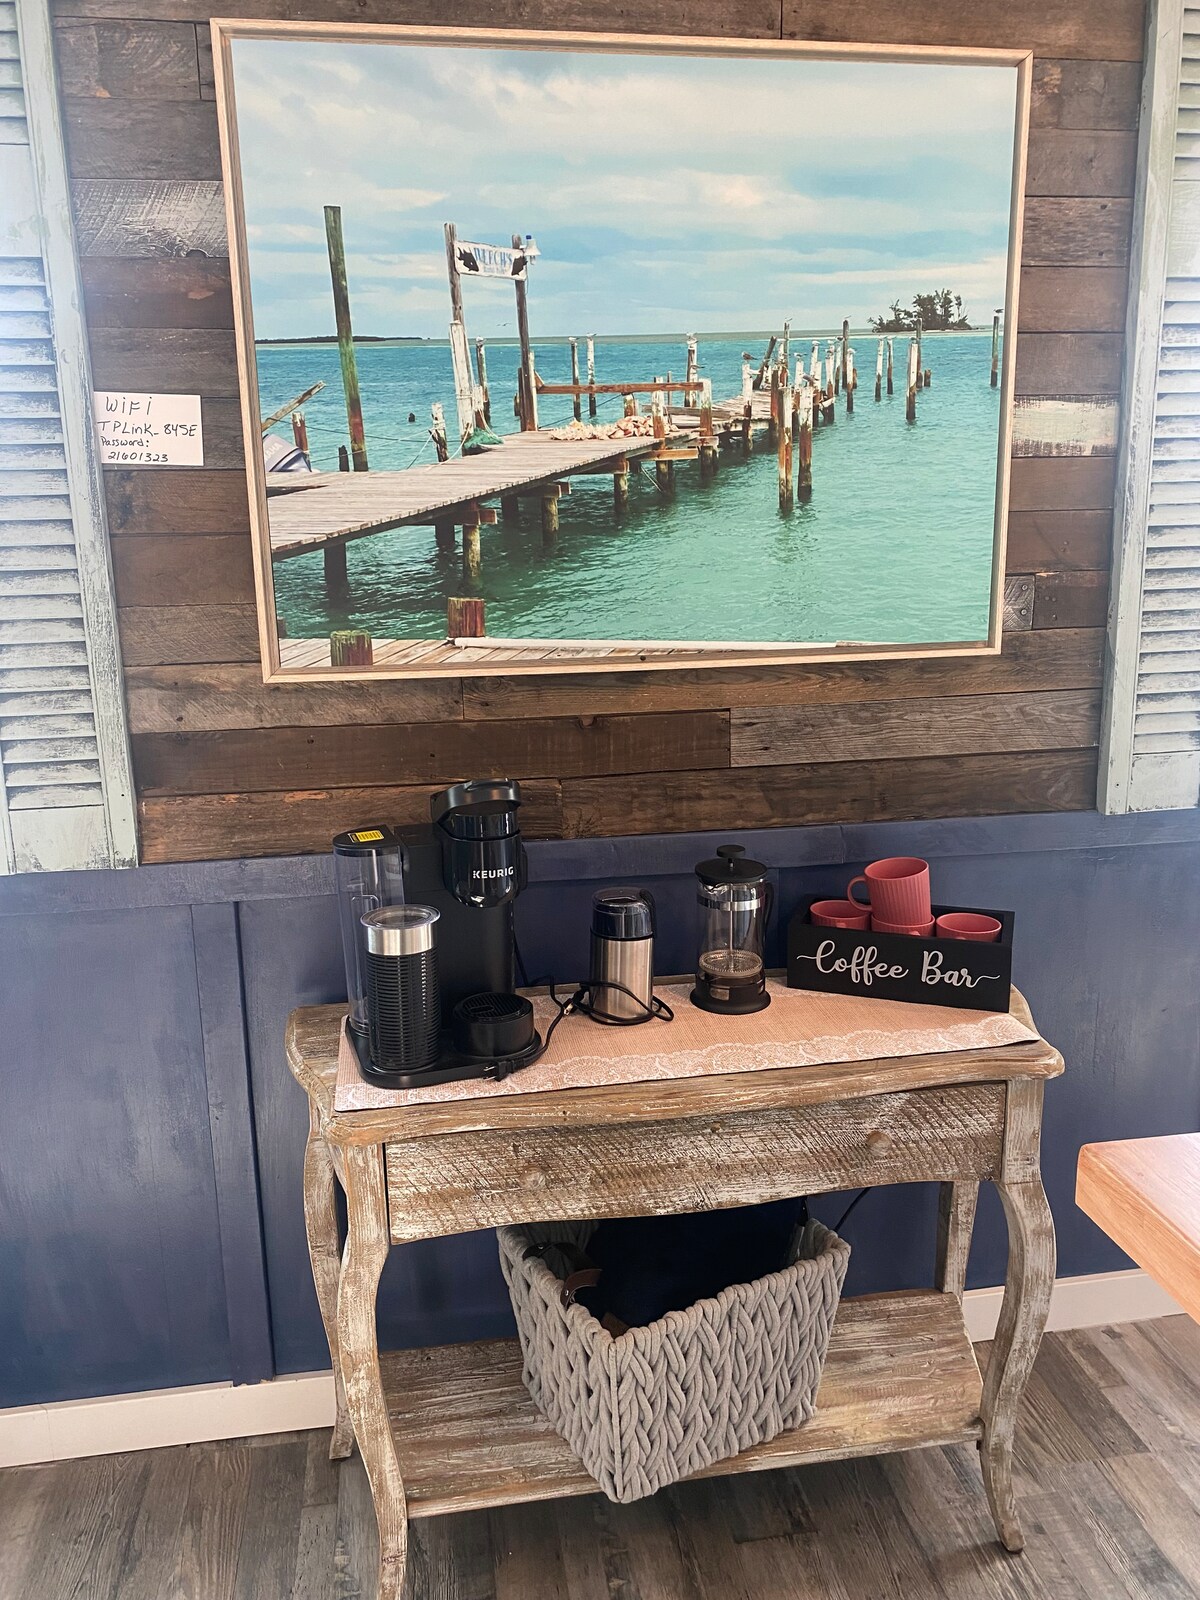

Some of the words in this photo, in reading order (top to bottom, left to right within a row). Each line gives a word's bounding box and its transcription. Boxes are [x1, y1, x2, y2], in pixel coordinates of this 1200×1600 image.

[100, 436, 149, 448] Password:
[108, 451, 169, 462] 21601323
[472, 866, 514, 879] KEURIG
[797, 940, 909, 986] Coffee
[920, 950, 1000, 988] Bar
